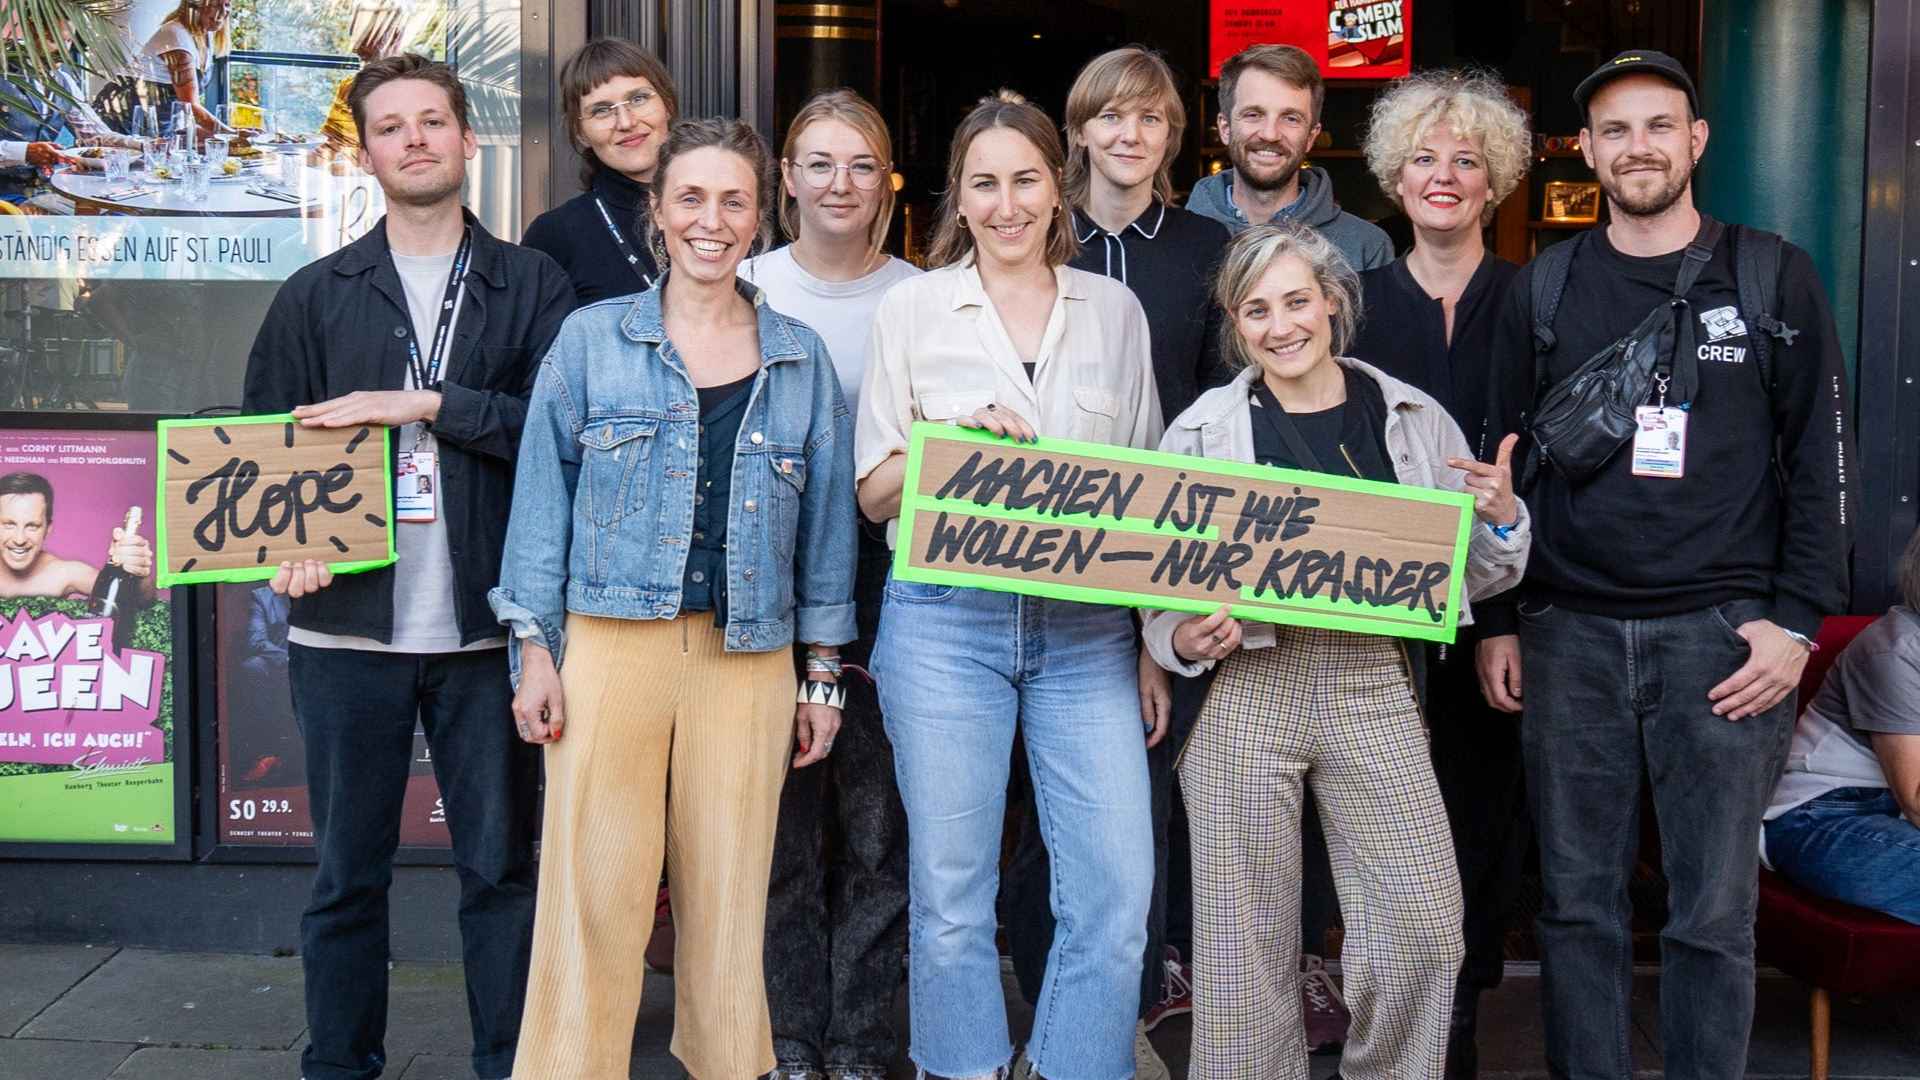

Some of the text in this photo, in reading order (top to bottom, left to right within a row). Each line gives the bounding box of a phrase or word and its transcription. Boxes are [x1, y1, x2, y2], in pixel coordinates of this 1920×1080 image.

[1344, 17, 1403, 43] SLAM
[144, 237, 179, 262] AUF
[187, 237, 212, 263] ST.
[219, 237, 271, 263] PAULI
[1697, 345, 1746, 363] CREW
[22, 444, 56, 453] CORNY
[935, 451, 1144, 521] MACHEN
[186, 457, 362, 551] Hope
[1254, 548, 1450, 623] KRASSER.
[0, 619, 103, 662] AVE
[43, 732, 76, 747] ICH
[229, 799, 292, 820] SO 29.9.
